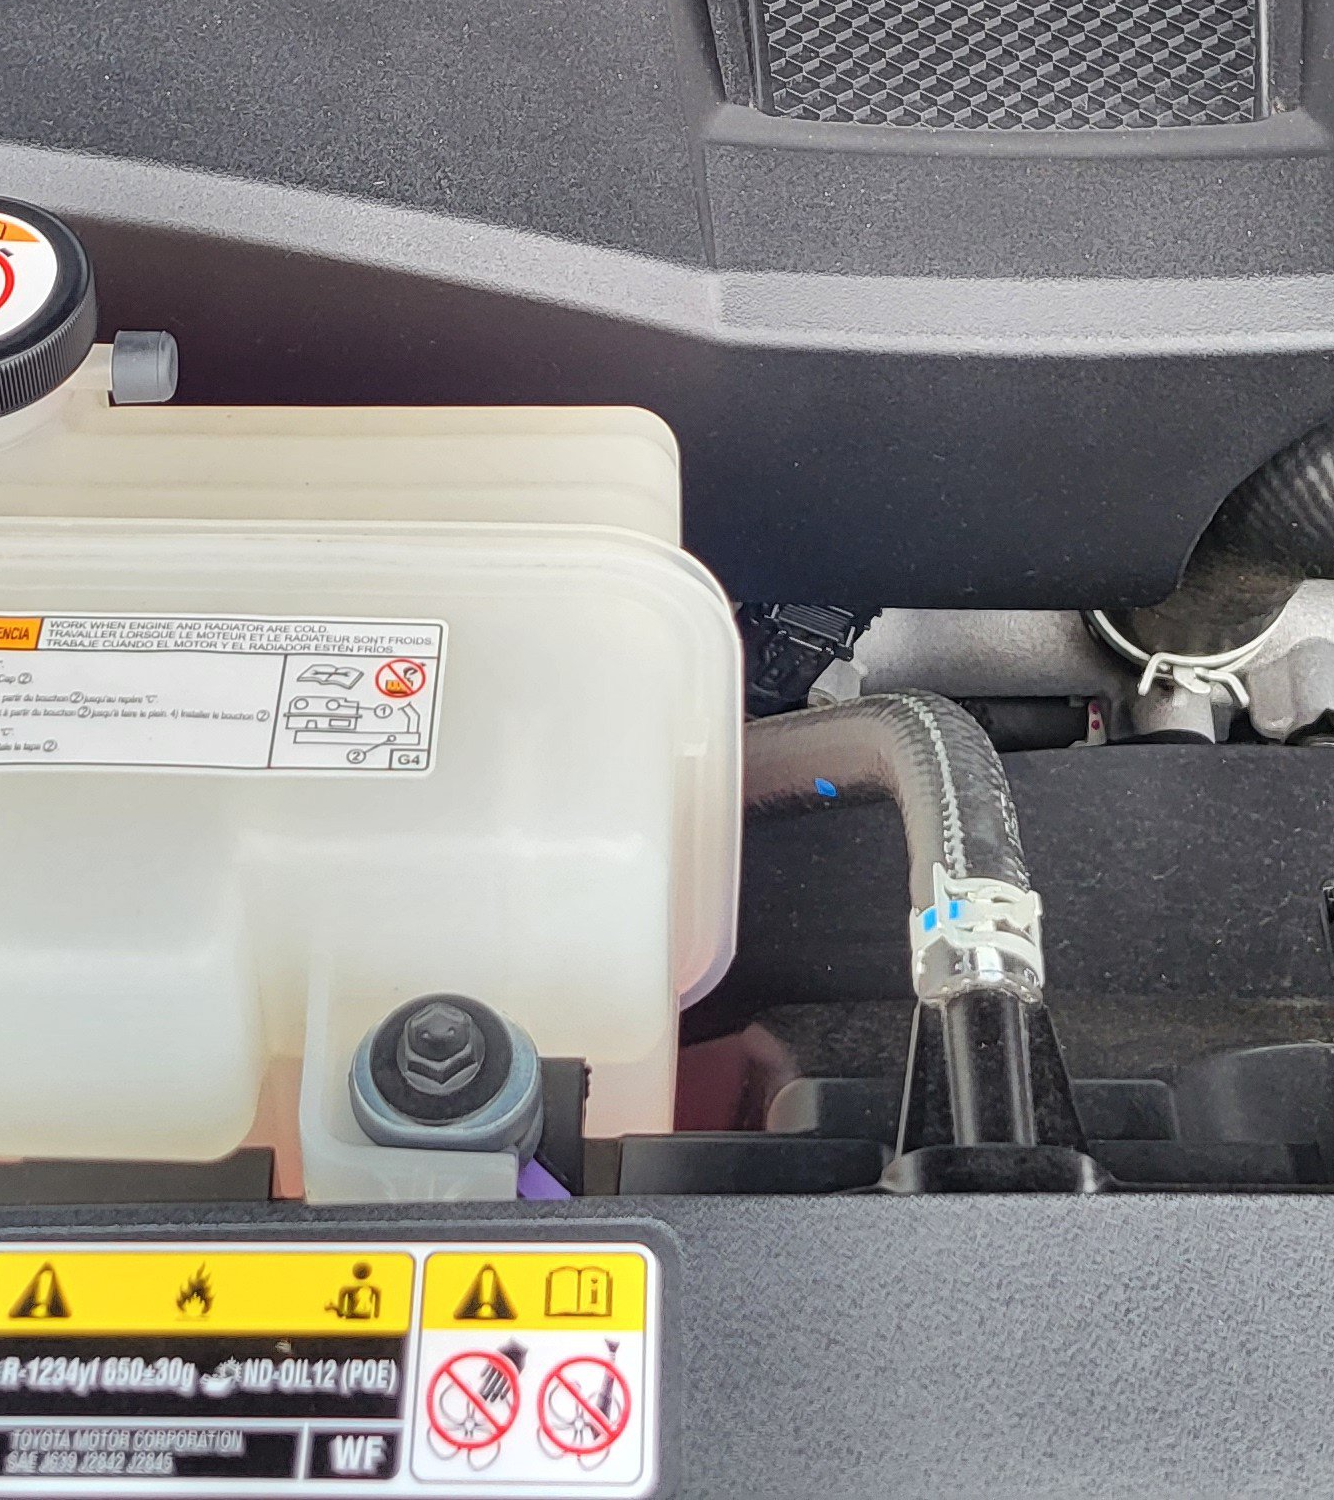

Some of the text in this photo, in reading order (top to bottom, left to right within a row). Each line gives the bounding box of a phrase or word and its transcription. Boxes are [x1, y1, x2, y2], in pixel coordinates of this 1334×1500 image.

[48, 628, 117, 639] TRAVAILLER
[119, 629, 176, 640] LORSQUE
[179, 631, 193, 640] LE
[196, 631, 246, 641] MOTEUR
[249, 633, 264, 642] ET
[266, 633, 281, 643] LE
[284, 634, 351, 644] RADIATEUR
[353, 635, 386, 645] SONT
[50, 620, 87, 630] WORK
[90, 621, 126, 630] WHEN
[129, 621, 174, 631] ENGINE
[176, 622, 202, 631] AND
[204, 622, 265, 633] RADIATOR
[266, 624, 290, 633] ARE
[46, 638, 99, 648] TRABAJE
[157, 640, 170, 649] EL
[173, 640, 218, 650] MOTOR
[220, 641, 229, 650] Y
[231, 641, 245, 651] EL
[249, 642, 311, 652] RADIADOR
[397, 753, 421, 765] G4
[2, 1356, 101, 1395] R-1234yf
[243, 1357, 338, 1391] ND-OIL12
[342, 1357, 398, 1395] (POE)
[11, 1429, 245, 1453] TOYOTA MOTOR CORPORATION
[5, 1451, 39, 1474] SAE
[332, 1435, 384, 1470] WF
